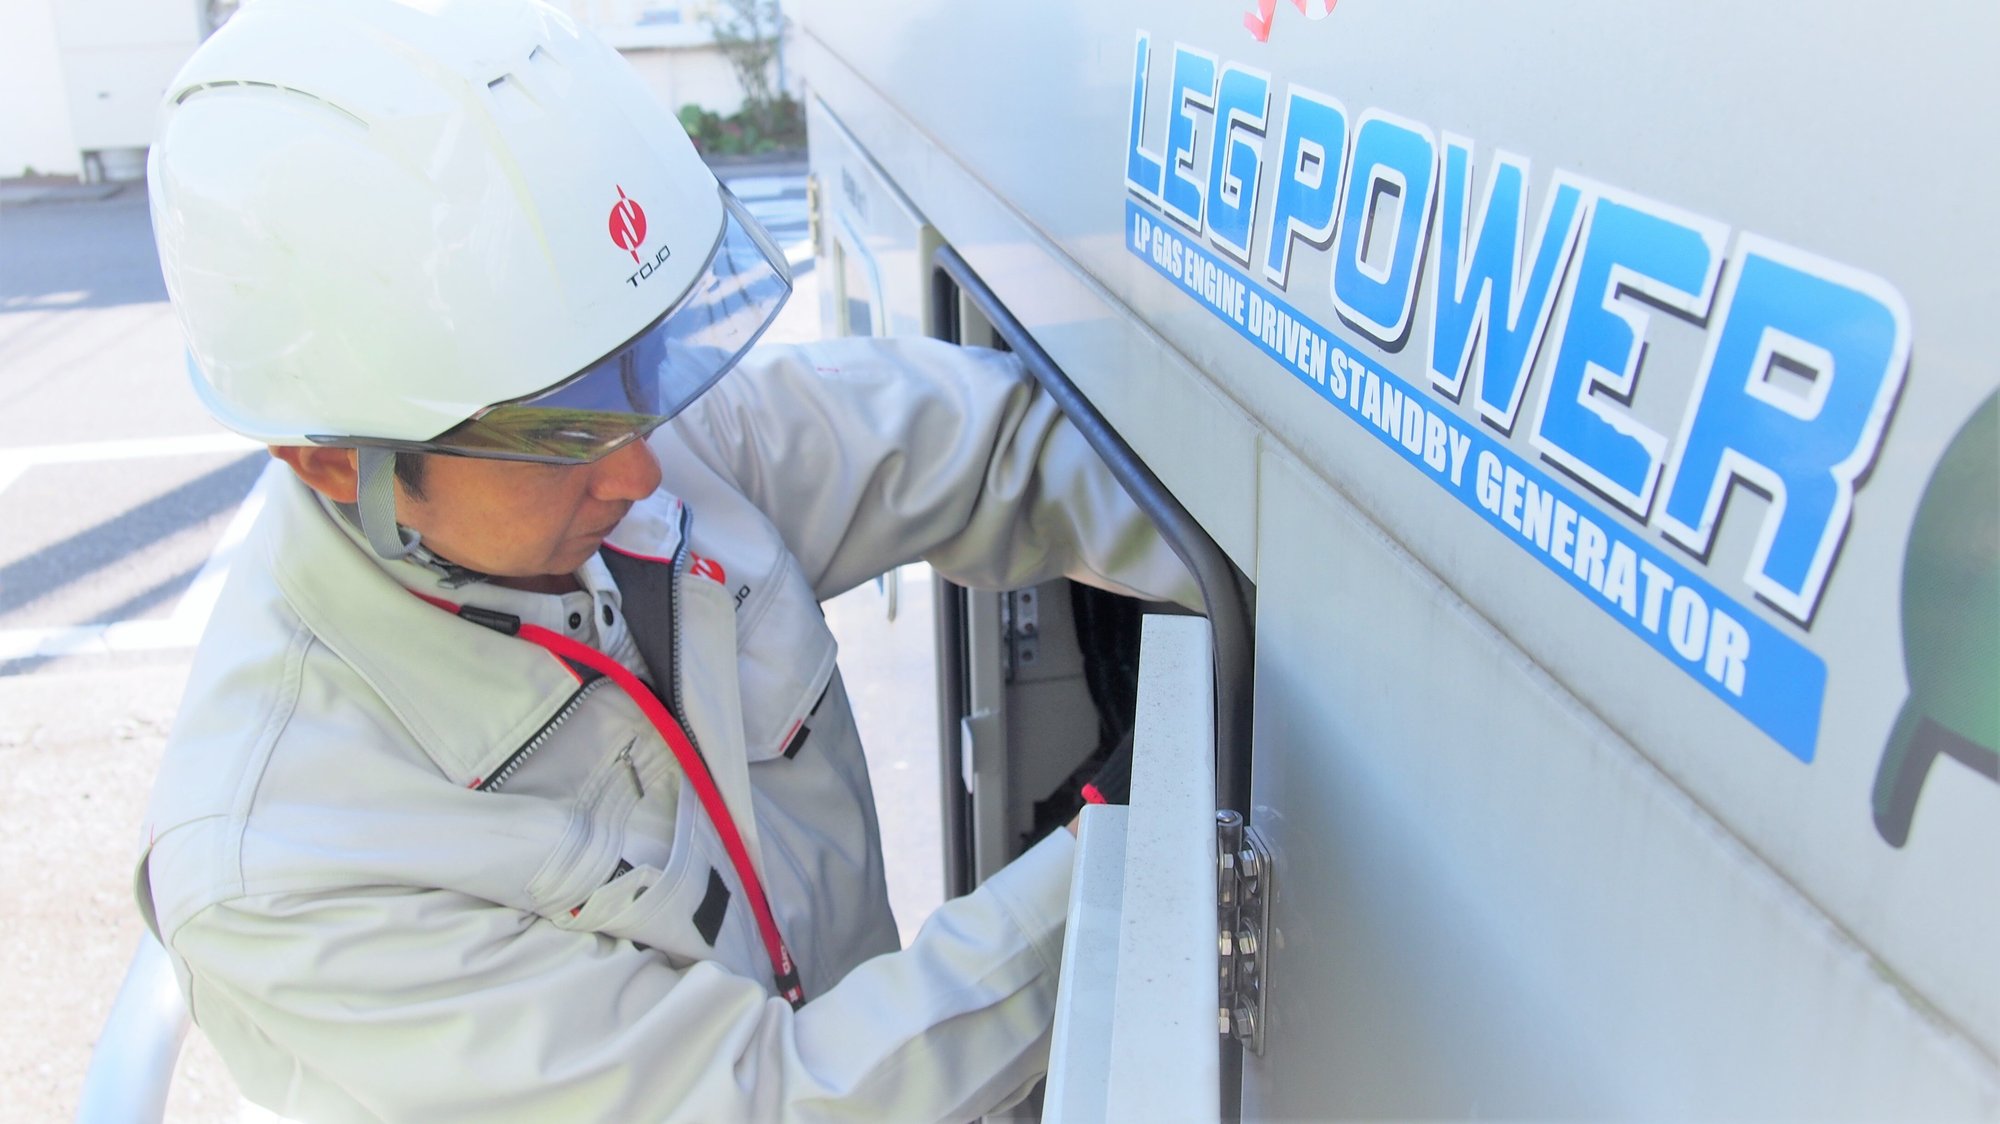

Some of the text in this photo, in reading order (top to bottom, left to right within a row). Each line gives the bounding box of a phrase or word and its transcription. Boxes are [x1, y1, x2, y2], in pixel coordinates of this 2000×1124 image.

[626, 245, 671, 288] TOJO
[1124, 28, 1911, 630] LEG POWER
[1134, 212, 1750, 698] LP GAS ENGINE DRIVEN STANDBY GENERATOR
